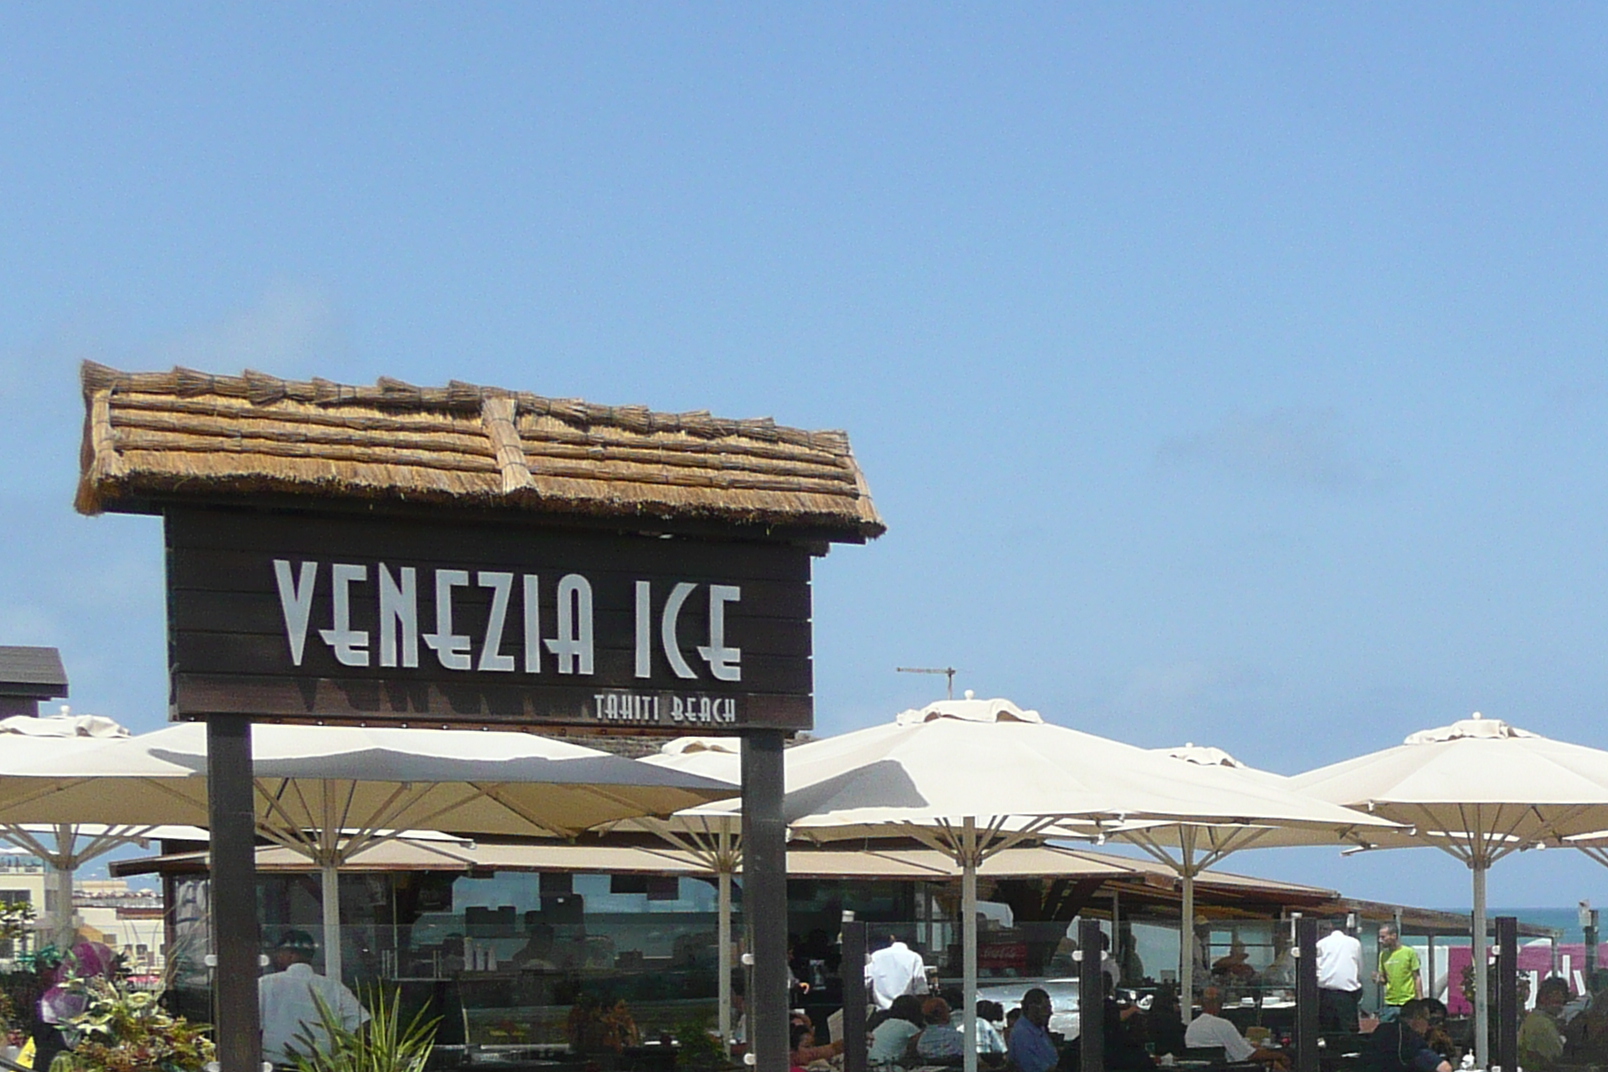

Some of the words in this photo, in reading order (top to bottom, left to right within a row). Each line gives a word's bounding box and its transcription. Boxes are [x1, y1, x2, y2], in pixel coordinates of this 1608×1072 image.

[273, 559, 594, 675] VENEZIA
[635, 580, 741, 681] ICE
[594, 694, 659, 721] TAHITI
[671, 695, 736, 722] BEACH
